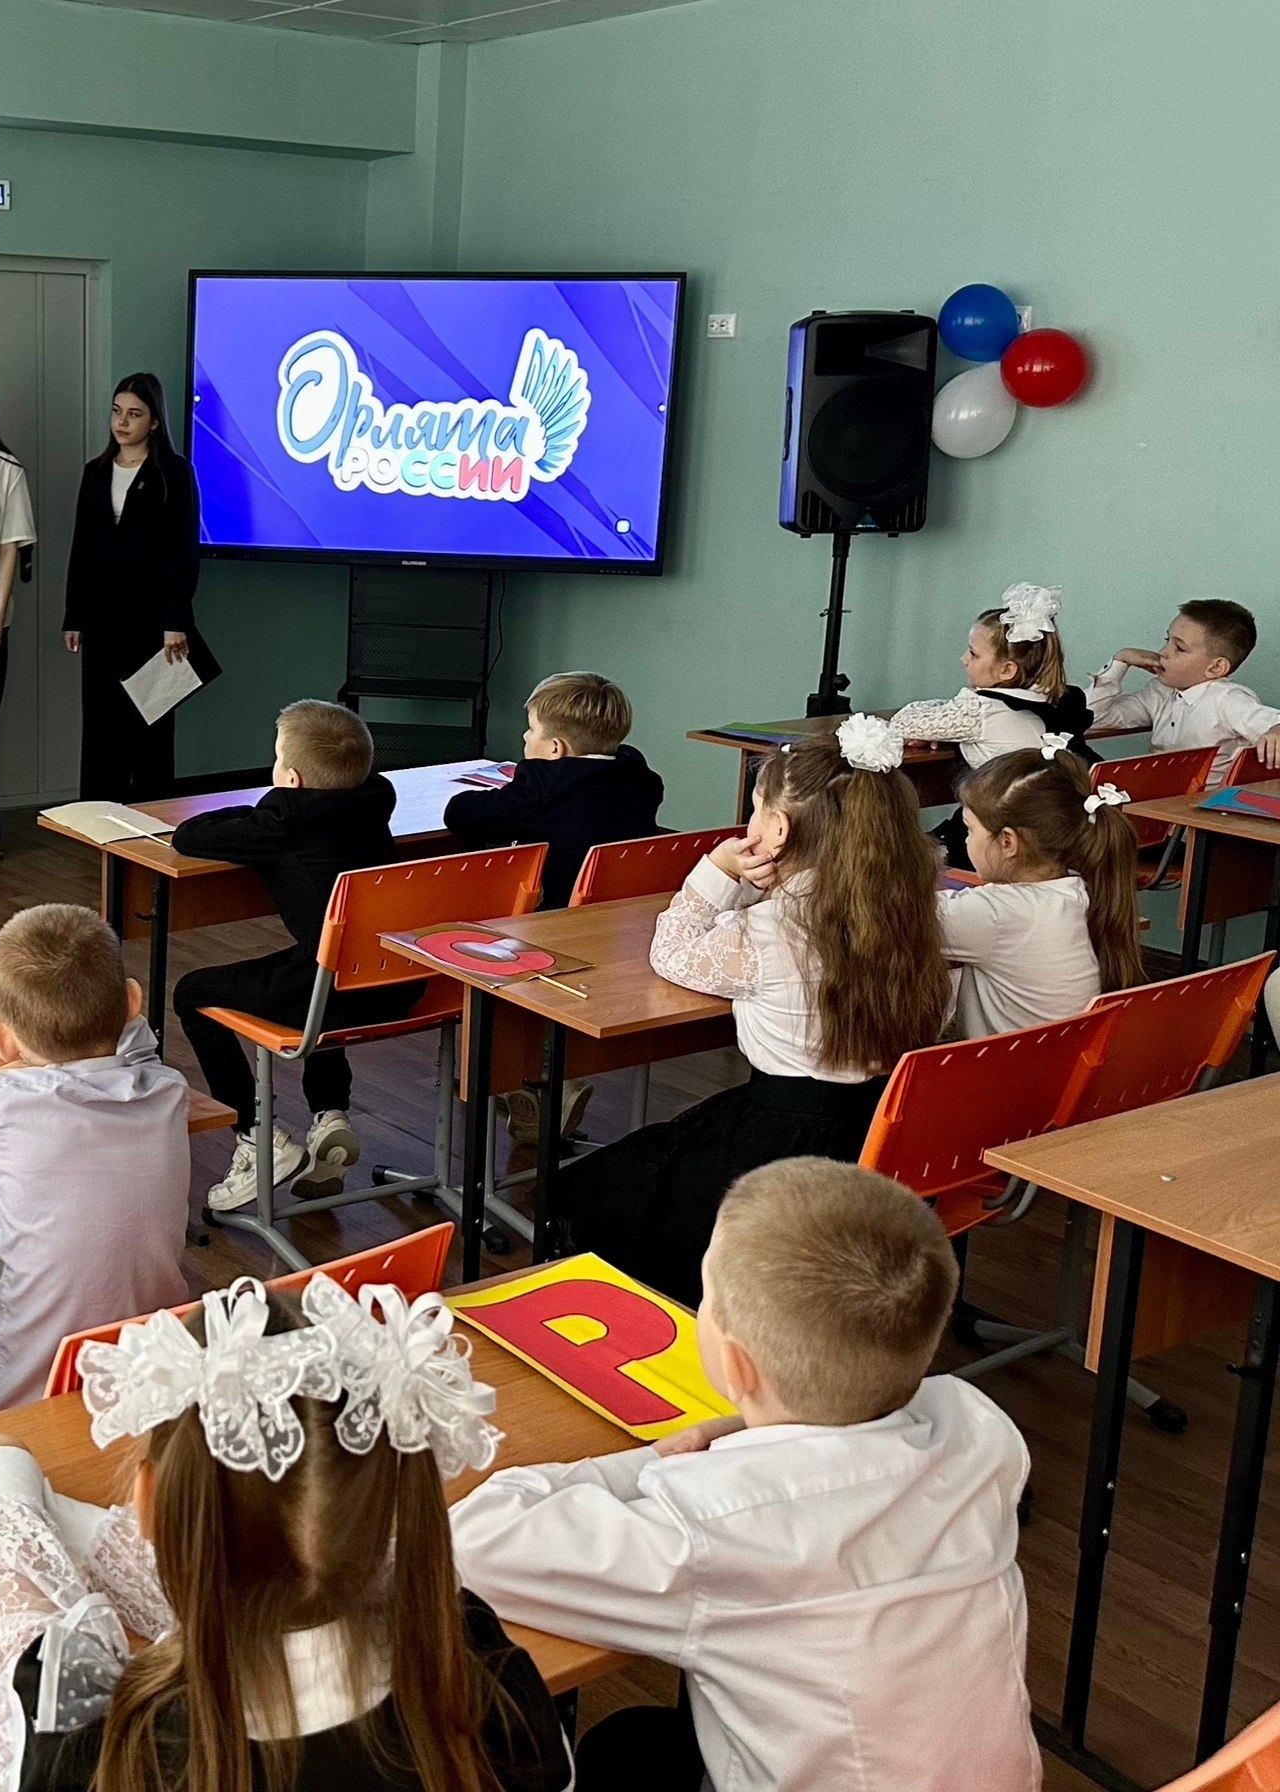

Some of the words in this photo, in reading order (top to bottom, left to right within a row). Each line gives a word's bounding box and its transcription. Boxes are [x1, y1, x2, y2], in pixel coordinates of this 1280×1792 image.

[281, 338, 531, 468] Орлята
[340, 446, 524, 494] РОССИИ
[455, 1279, 686, 1426] Р
